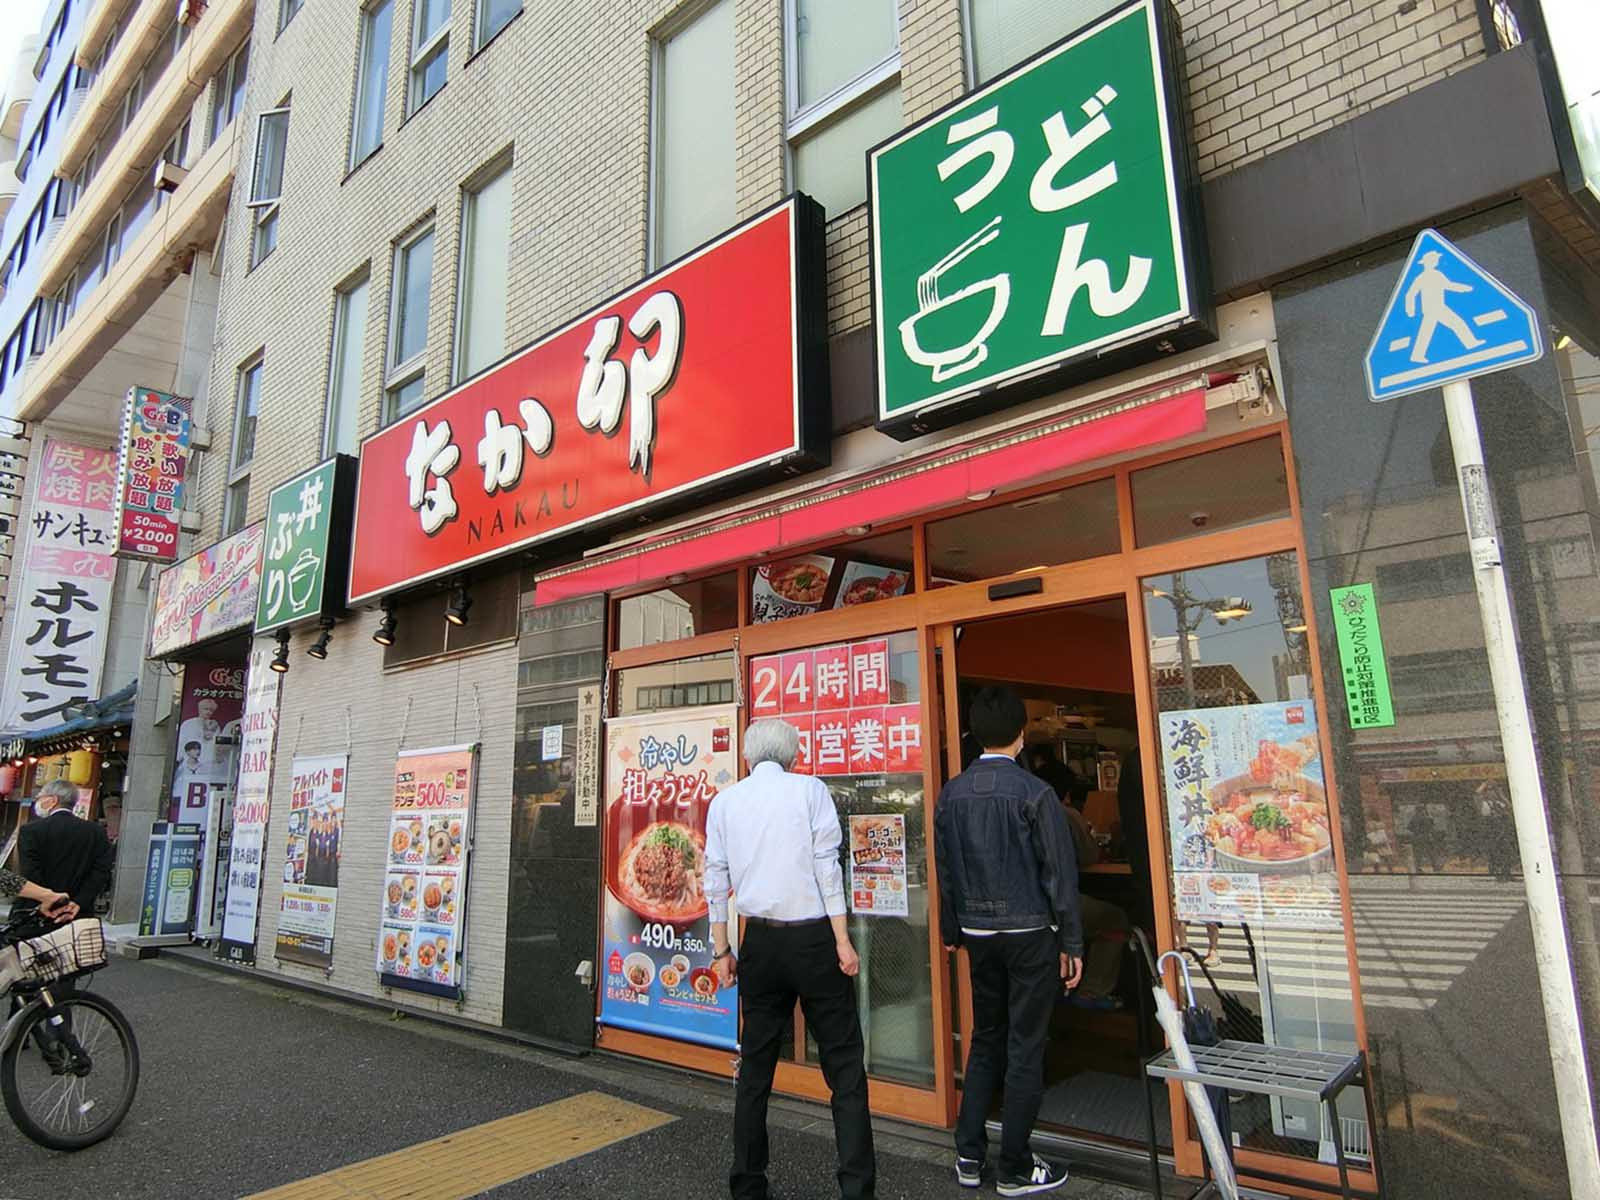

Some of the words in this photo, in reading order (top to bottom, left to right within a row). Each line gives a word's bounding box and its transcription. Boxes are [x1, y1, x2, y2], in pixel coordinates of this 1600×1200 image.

[936, 84, 1152, 336] うどん
[405, 290, 682, 535] なか卯
[130, 436, 152, 508] 飲み放題
[155, 441, 179, 511] 歌い放題
[33, 511, 110, 546] サンキュ
[467, 479, 580, 545] NAKAU
[20, 581, 99, 721] ホルモン
[754, 651, 886, 708] 24時間
[242, 752, 267, 773] BAR
